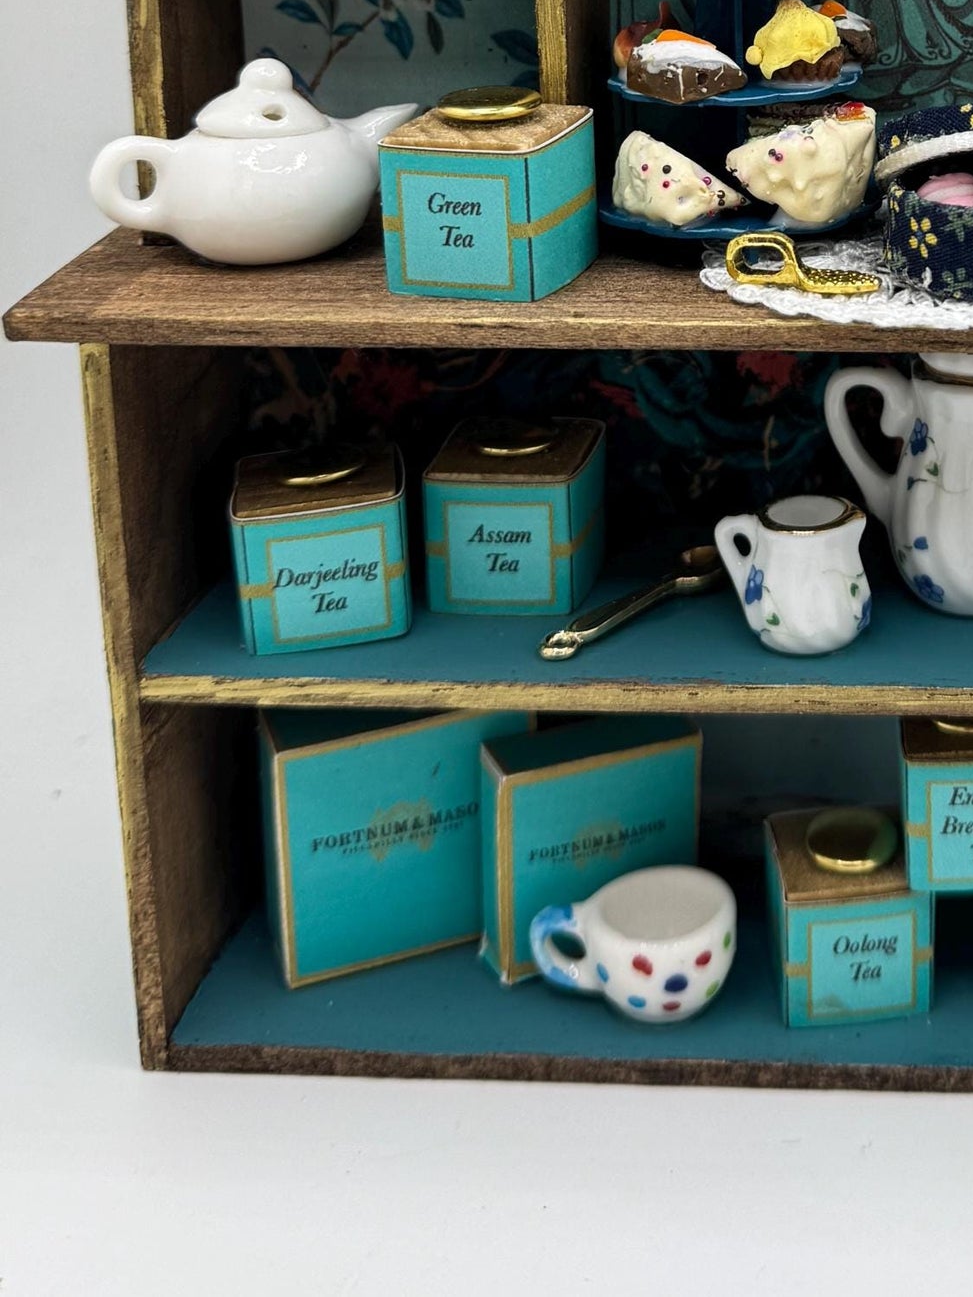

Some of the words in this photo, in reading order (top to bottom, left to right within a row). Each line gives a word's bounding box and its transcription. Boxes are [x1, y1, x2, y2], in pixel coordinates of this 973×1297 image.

[427, 192, 482, 216] Green
[439, 225, 475, 249] Tea
[467, 523, 532, 544] Assam
[485, 552, 520, 573] Tea
[271, 559, 380, 592] Darjeeling
[311, 591, 348, 615] Tea
[312, 817, 408, 852] FORTNUM
[428, 802, 480, 827] MASO
[832, 934, 898, 957] Oolong
[852, 962, 882, 983] Tea
